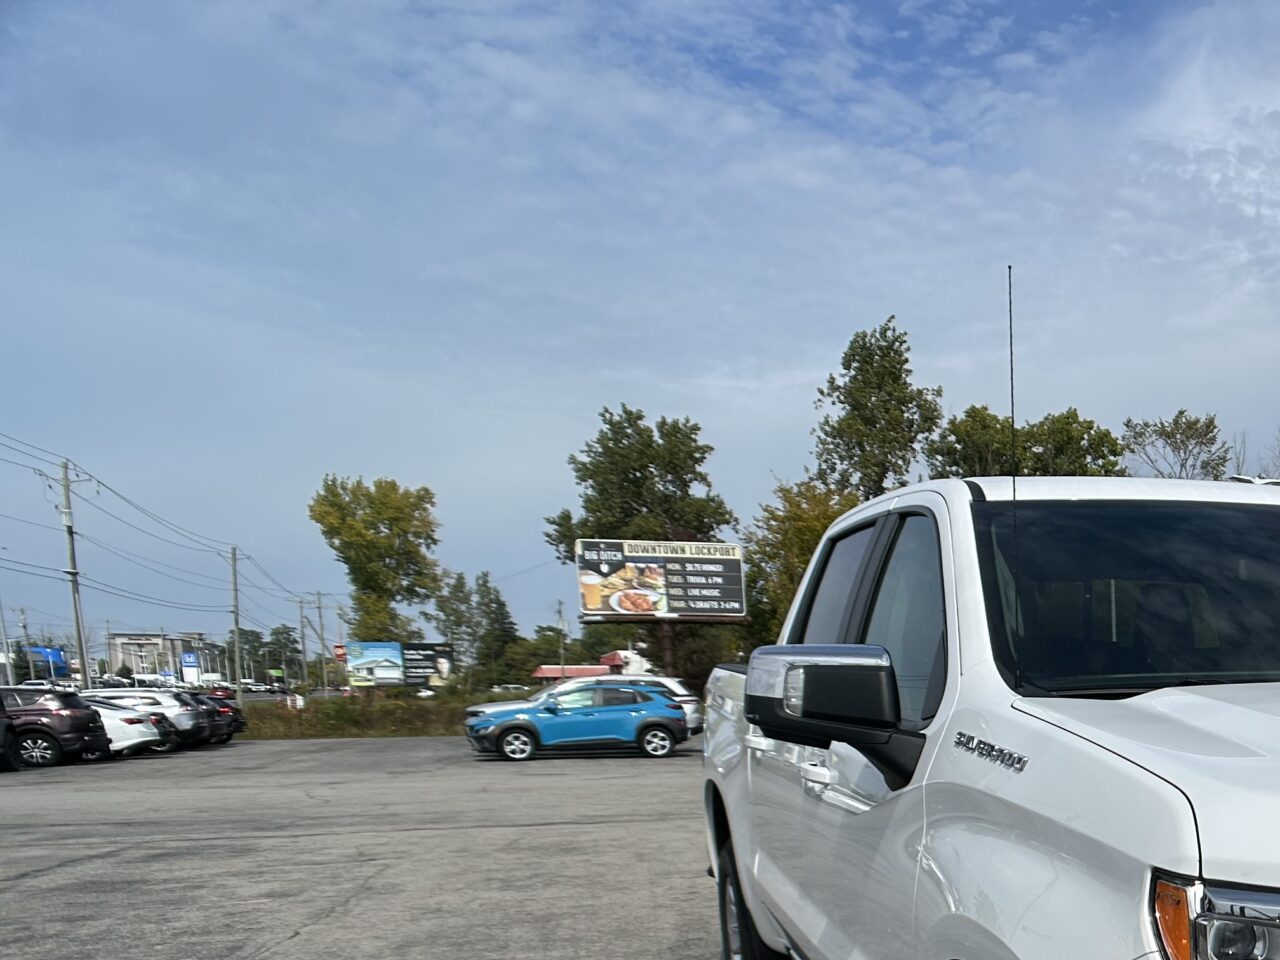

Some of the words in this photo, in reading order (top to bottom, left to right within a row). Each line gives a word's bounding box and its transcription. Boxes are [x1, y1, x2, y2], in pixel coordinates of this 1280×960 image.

[584, 550, 598, 560] BIG
[599, 551, 623, 560] DITCH
[627, 543, 686, 555] DOWNTOWN
[689, 545, 737, 556] LOCKPORT
